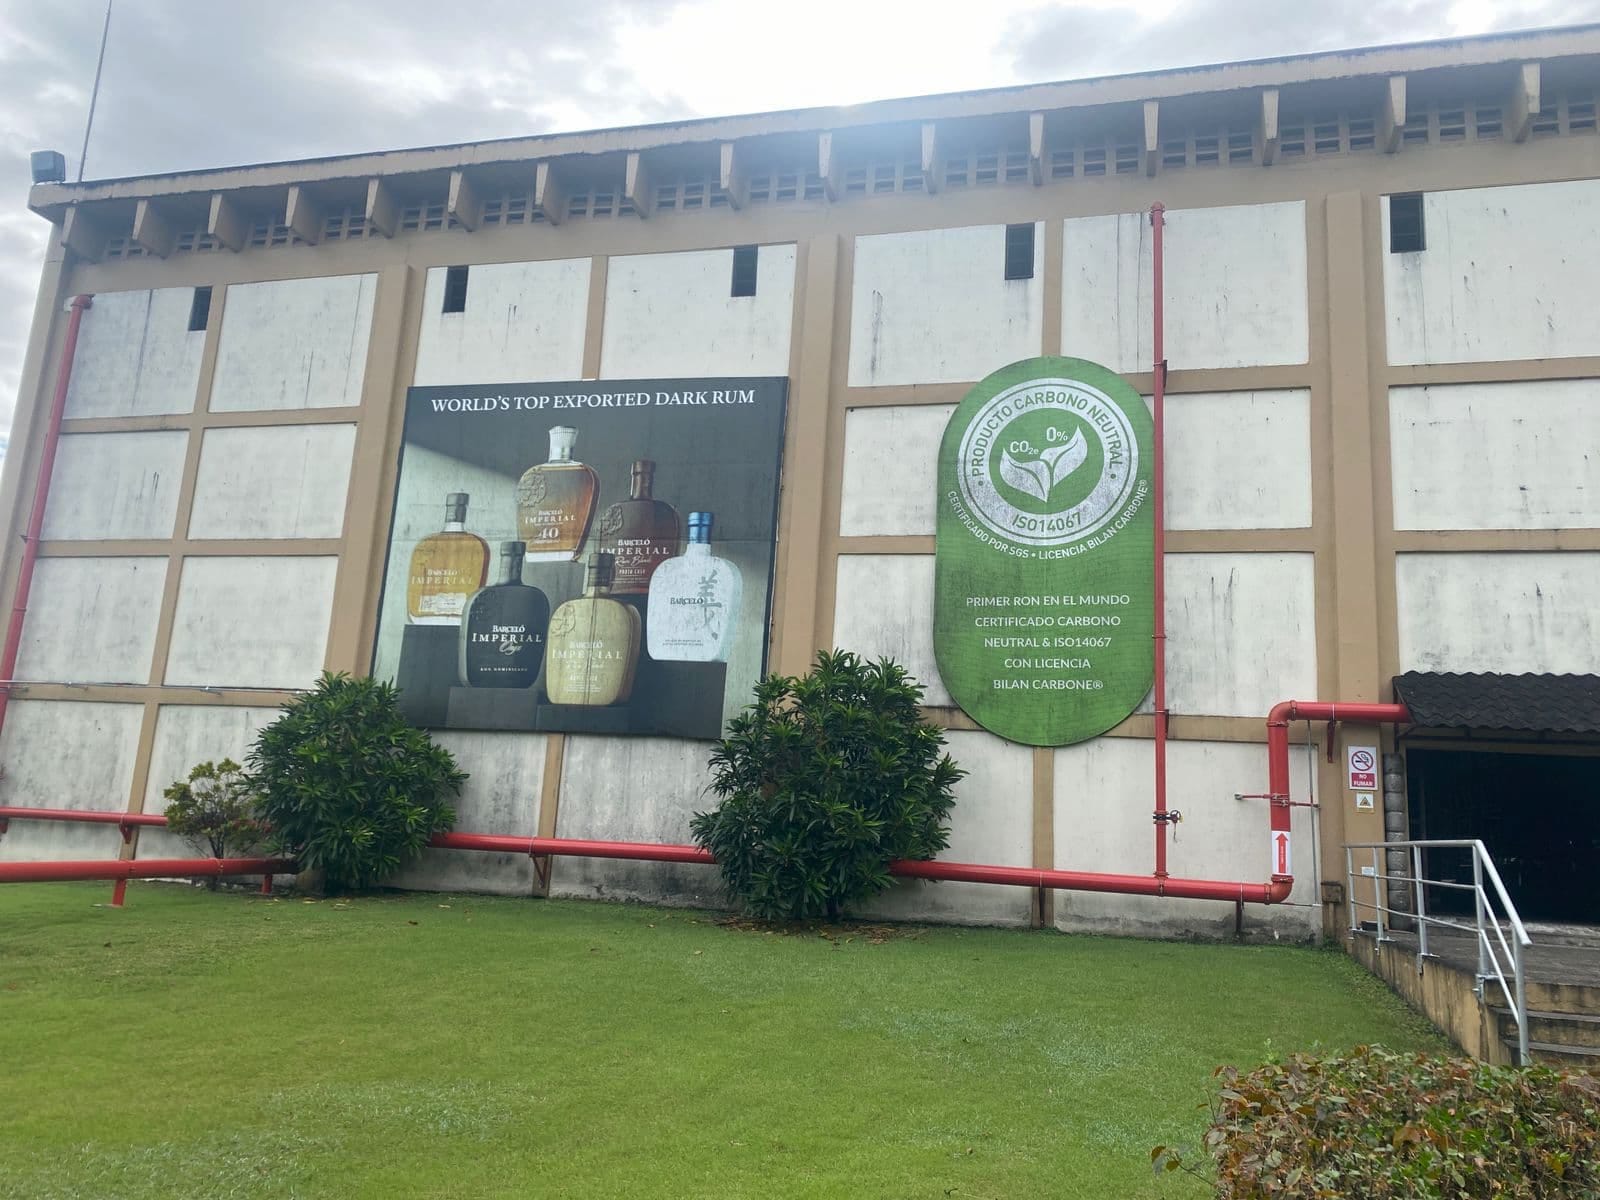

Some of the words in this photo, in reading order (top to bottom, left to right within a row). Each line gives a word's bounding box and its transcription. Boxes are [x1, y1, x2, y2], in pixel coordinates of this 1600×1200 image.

[431, 395, 510, 412] WORLD’S
[513, 395, 550, 410] TOP
[553, 392, 651, 409] EXPORTED
[654, 391, 708, 406] DARK
[711, 389, 756, 404] RUM
[972, 405, 1014, 477] PRODUCTO
[1013, 391, 1088, 411] CARBONO
[1086, 404, 1123, 470] NEUTRAL
[1046, 426, 1068, 442] 0%
[525, 514, 576, 524] IMPERIAL
[1011, 511, 1082, 533] ISO14067
[947, 490, 988, 542] CERTIFICADO
[987, 537, 1008, 553] POR
[1009, 545, 1029, 559] SGS
[1038, 544, 1088, 560] LICENCIA
[1087, 526, 1119, 549] BILAN
[538, 527, 559, 539] 40
[600, 547, 670, 555] IMPERIAL
[411, 576, 473, 585] IMPERIAL
[966, 596, 1010, 607] PRIMER
[1013, 595, 1040, 606] RON
[1043, 595, 1060, 606] EN
[1063, 595, 1077, 606] EL
[1079, 594, 1130, 605] MUNDO
[975, 617, 1054, 627] CERTIFICADO
[1057, 616, 1121, 626] CARBONO
[471, 632, 542, 643] IMPERIAL
[984, 638, 1040, 648] NEUTRAL
[1042, 637, 1051, 647] &
[1054, 637, 1112, 647] ISO14067
[1004, 658, 1032, 669] CON
[1035, 658, 1092, 668] LICENCIA
[993, 679, 1029, 690] BILAN
